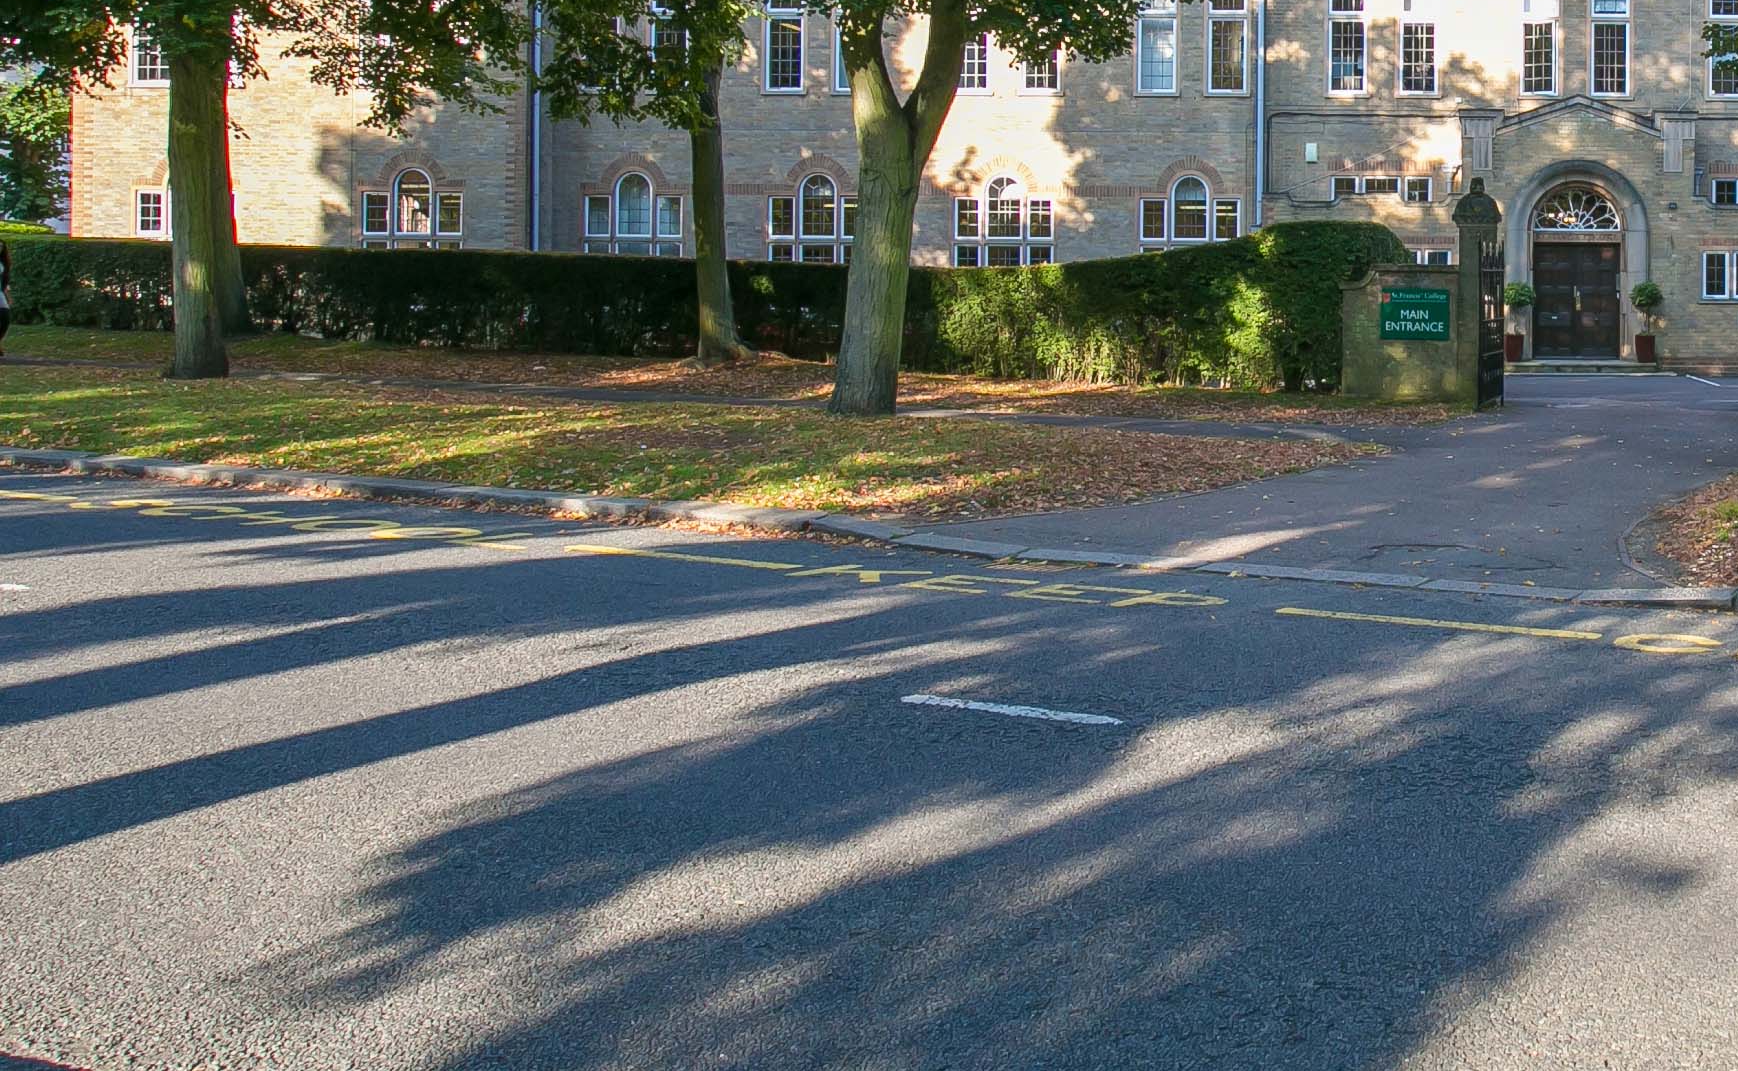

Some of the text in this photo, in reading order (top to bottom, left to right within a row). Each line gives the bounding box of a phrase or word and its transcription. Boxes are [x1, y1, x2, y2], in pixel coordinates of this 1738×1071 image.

[1385, 321, 1444, 332] ENTRANCE
[1400, 309, 1429, 320] MAIN
[69, 499, 533, 550] SCHOOL
[784, 564, 1229, 607] KEEP
